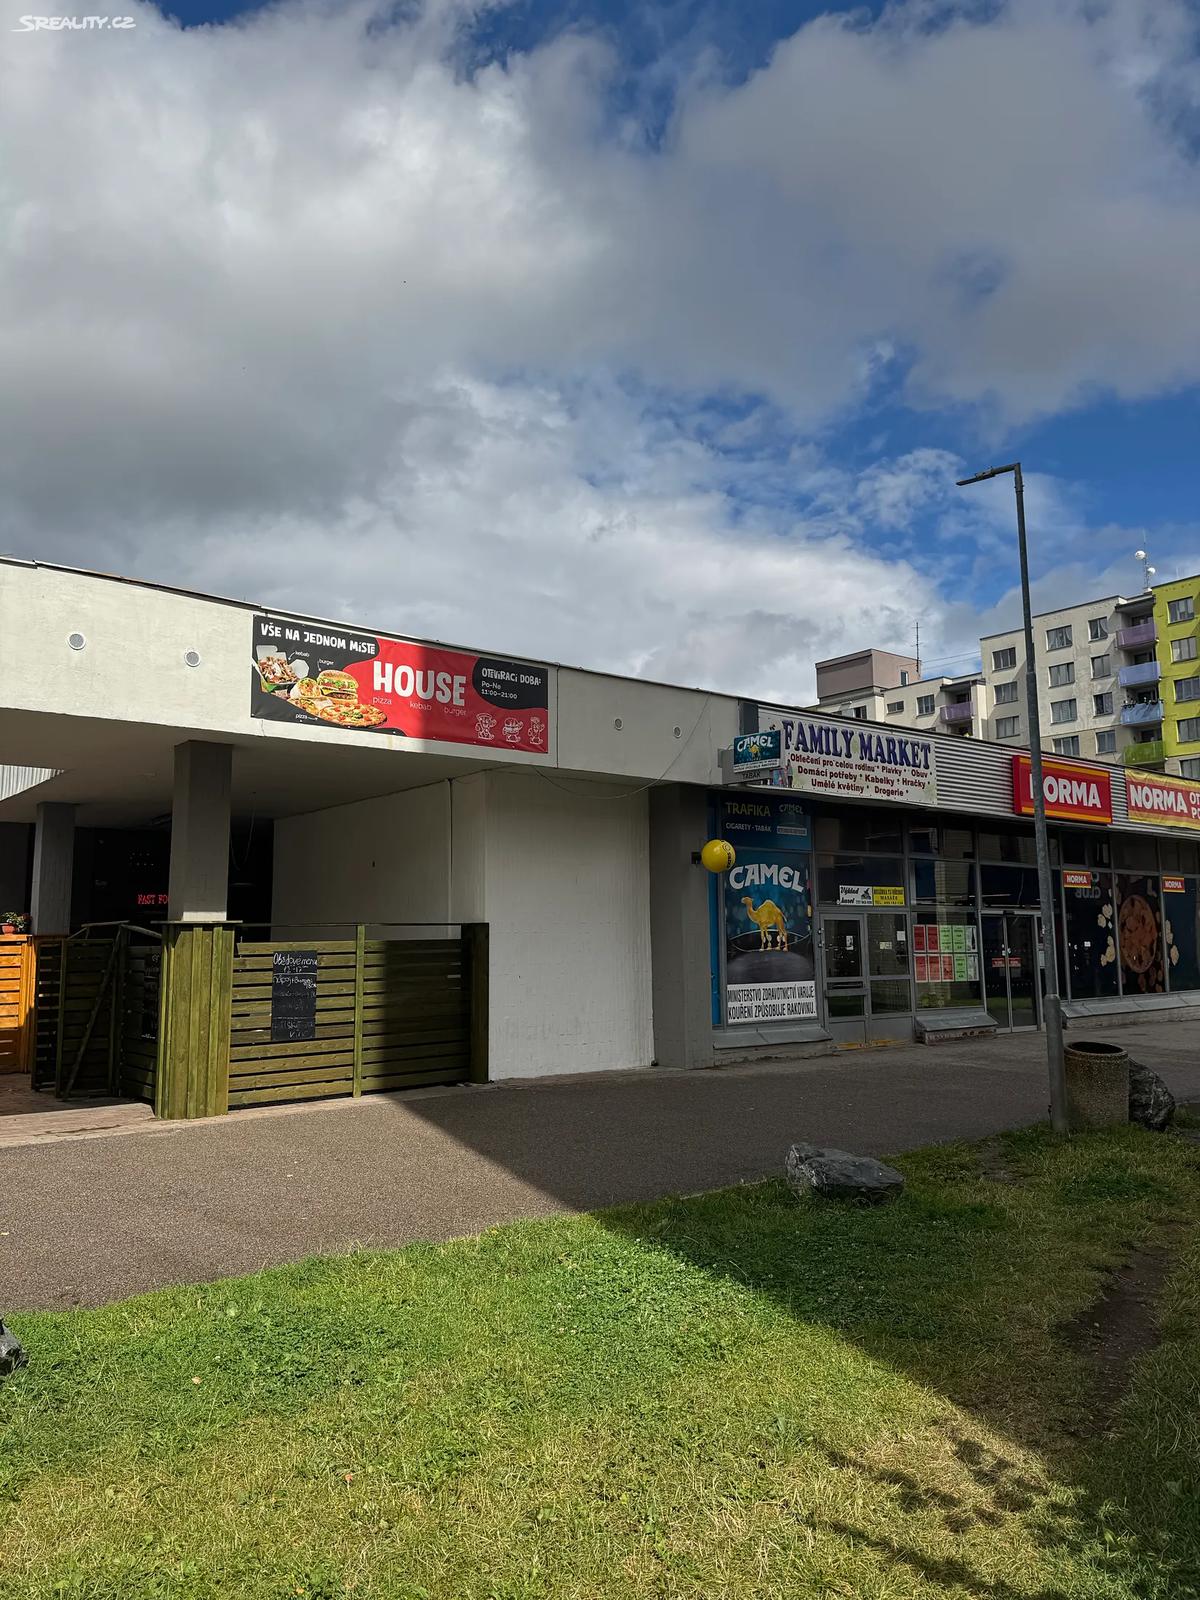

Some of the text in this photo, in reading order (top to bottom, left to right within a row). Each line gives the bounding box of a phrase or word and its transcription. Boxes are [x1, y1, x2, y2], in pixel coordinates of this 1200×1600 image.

[261, 622, 281, 637] VŠE
[285, 628, 300, 641] NA
[303, 631, 346, 649] JEDNOM
[319, 658, 334, 666] burger
[373, 660, 466, 706] HOUSE
[519, 674, 542, 686] DOBA:
[372, 696, 392, 705] pizza
[409, 701, 432, 711] kebab
[443, 707, 466, 717] burger
[737, 735, 774, 752] CAMEL
[782, 719, 931, 770] FAMILY MARKET
[790, 753, 821, 765] Oblečení
[822, 759, 834, 768] pro
[835, 760, 854, 770] celou
[881, 765, 903, 777] Plavky
[910, 768, 929, 778] Obuv
[797, 765, 926, 790] Domácí potřeby Kabelky Hračky
[811, 777, 905, 797] Umělé květiny Drogerie
[1129, 784, 1189, 813] NORMA
[726, 802, 771, 817] TRAFIKA
[778, 803, 804, 815] CAMEL
[725, 822, 752, 832] CIGARETY
[729, 863, 805, 893] CAMEL
[1066, 874, 1088, 884] NORMA
[1164, 880, 1182, 889] NORMA
[137, 893, 156, 905] FAST
[728, 988, 762, 1003] MINISTERSTVO
[728, 1003, 754, 1020] KOUŘENÍ
[754, 1002, 787, 1018] ZPŮSOBUJE
